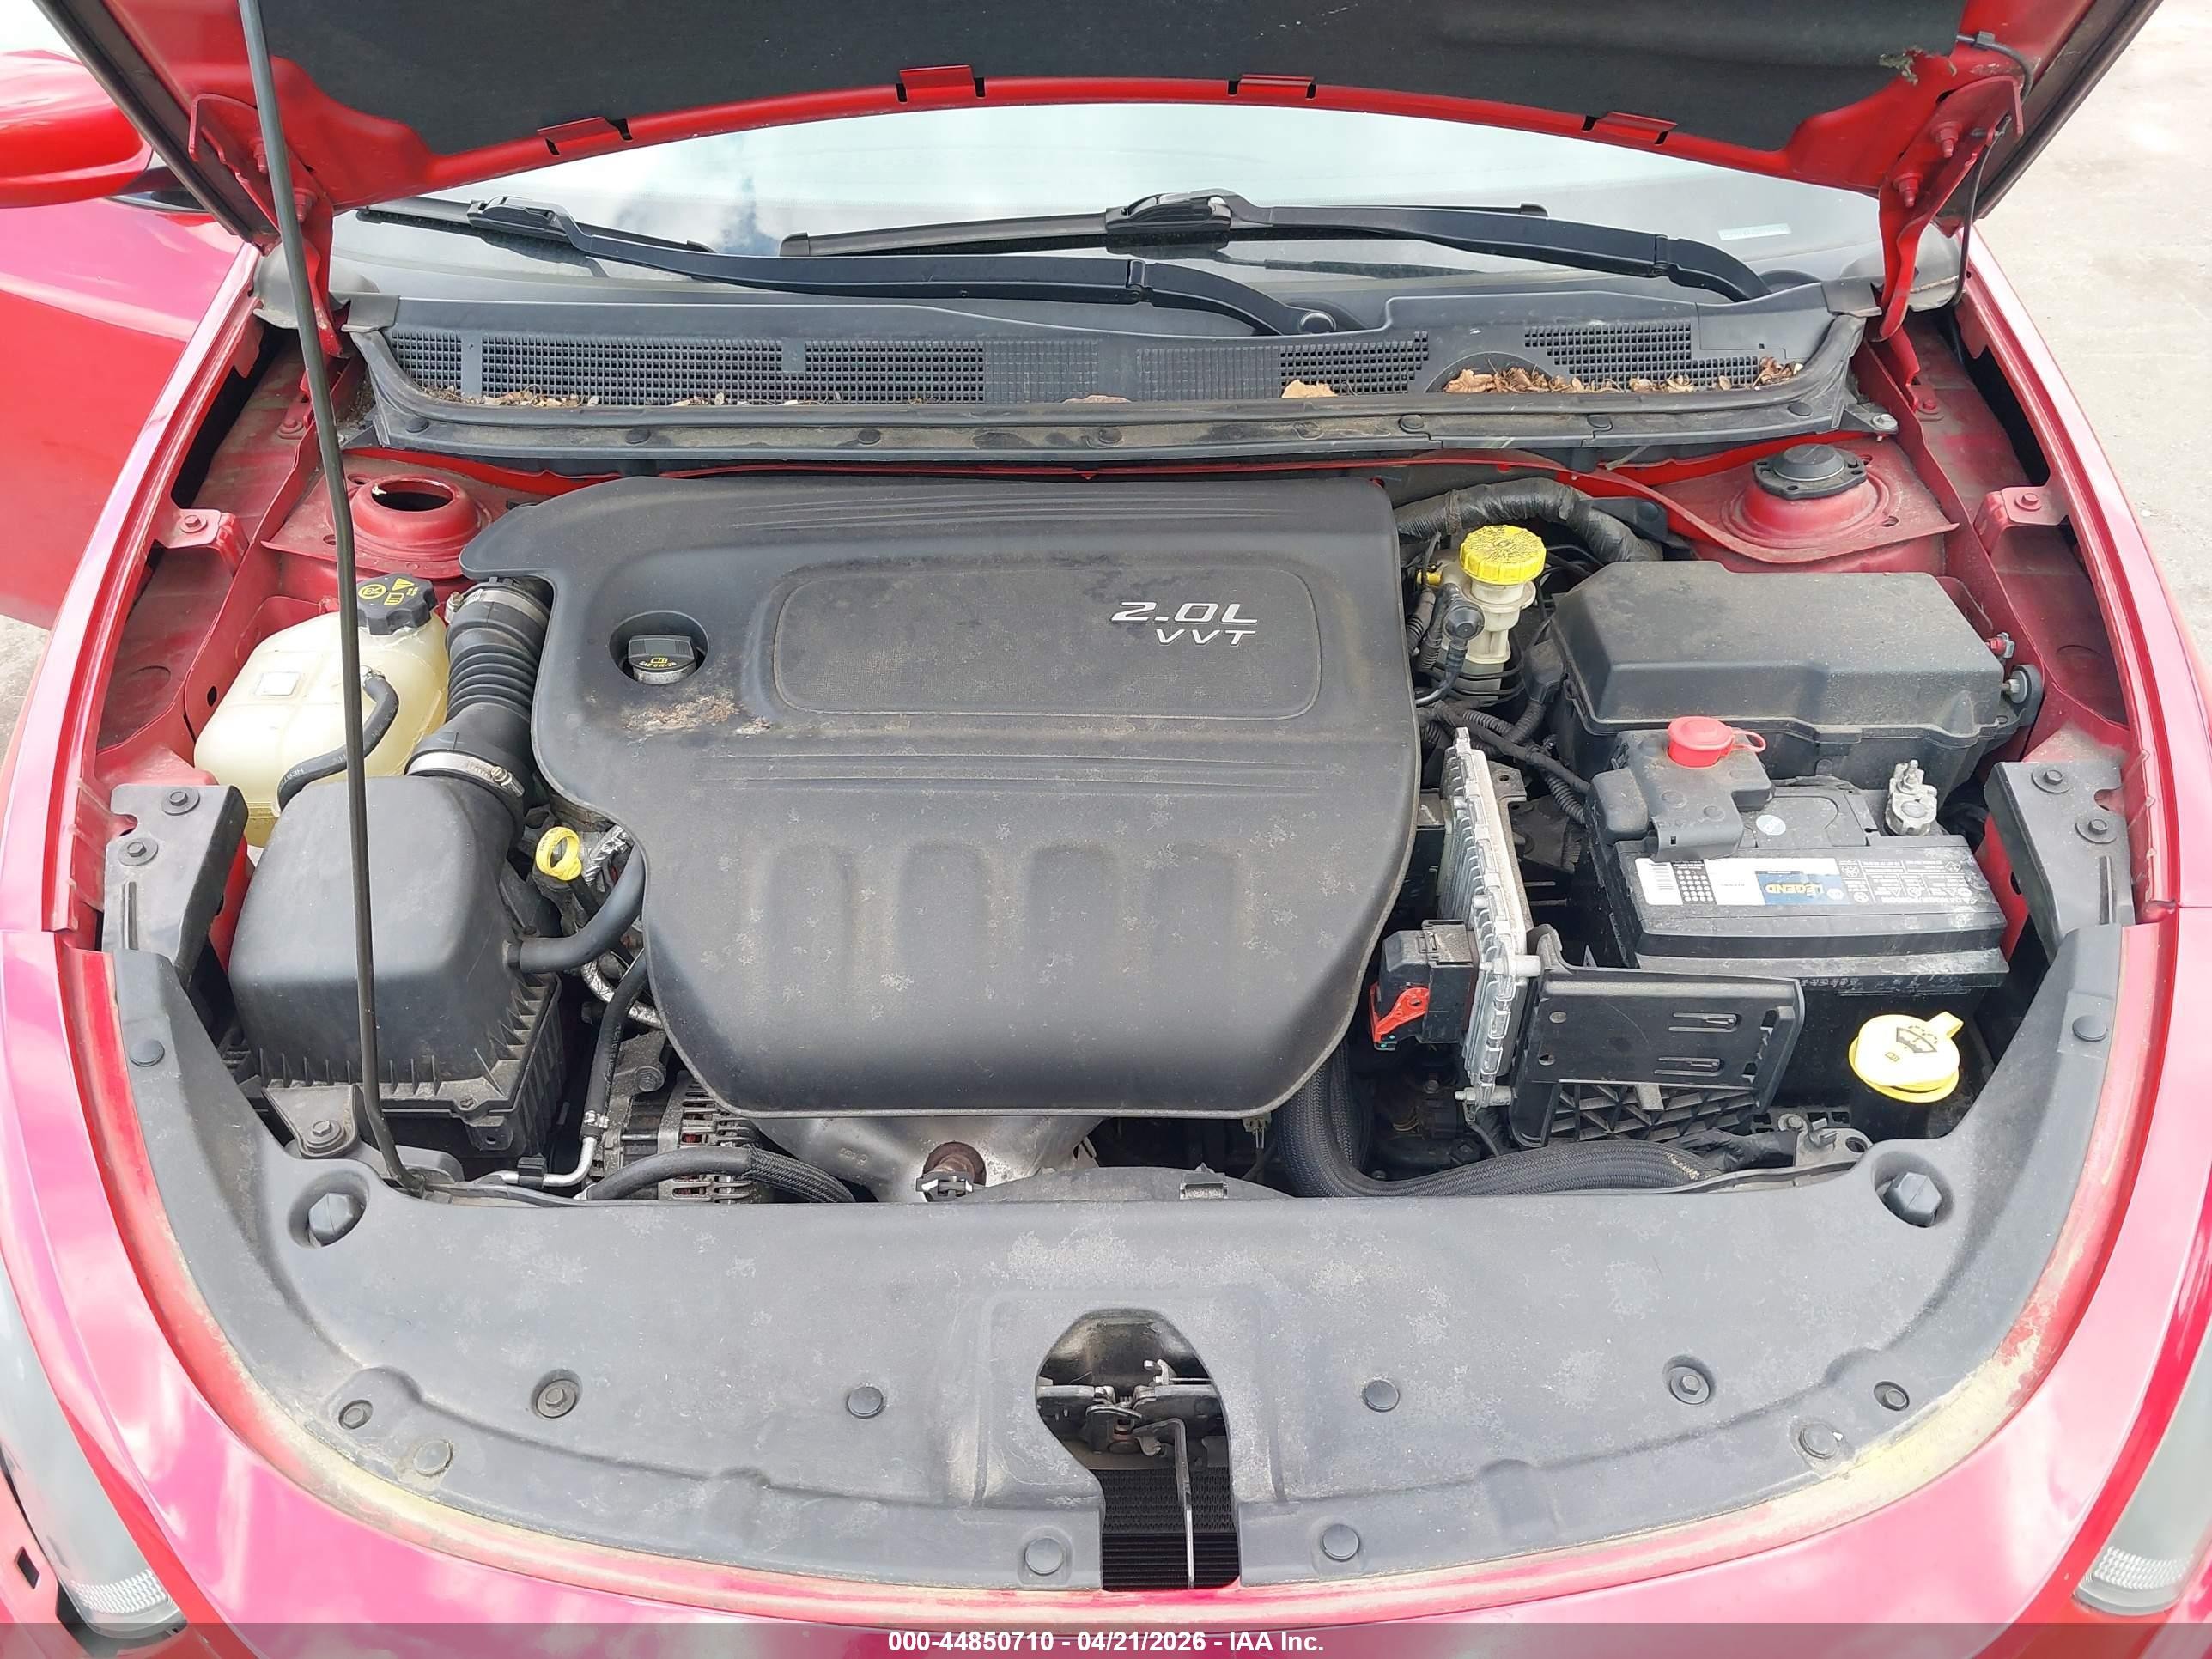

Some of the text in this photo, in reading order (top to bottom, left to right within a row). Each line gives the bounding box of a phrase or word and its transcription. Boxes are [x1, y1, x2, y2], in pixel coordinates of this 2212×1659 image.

[1111, 601, 1258, 623] 2.0L
[1156, 629, 1256, 647] VVT
[1765, 883, 1824, 895] LEGEND
